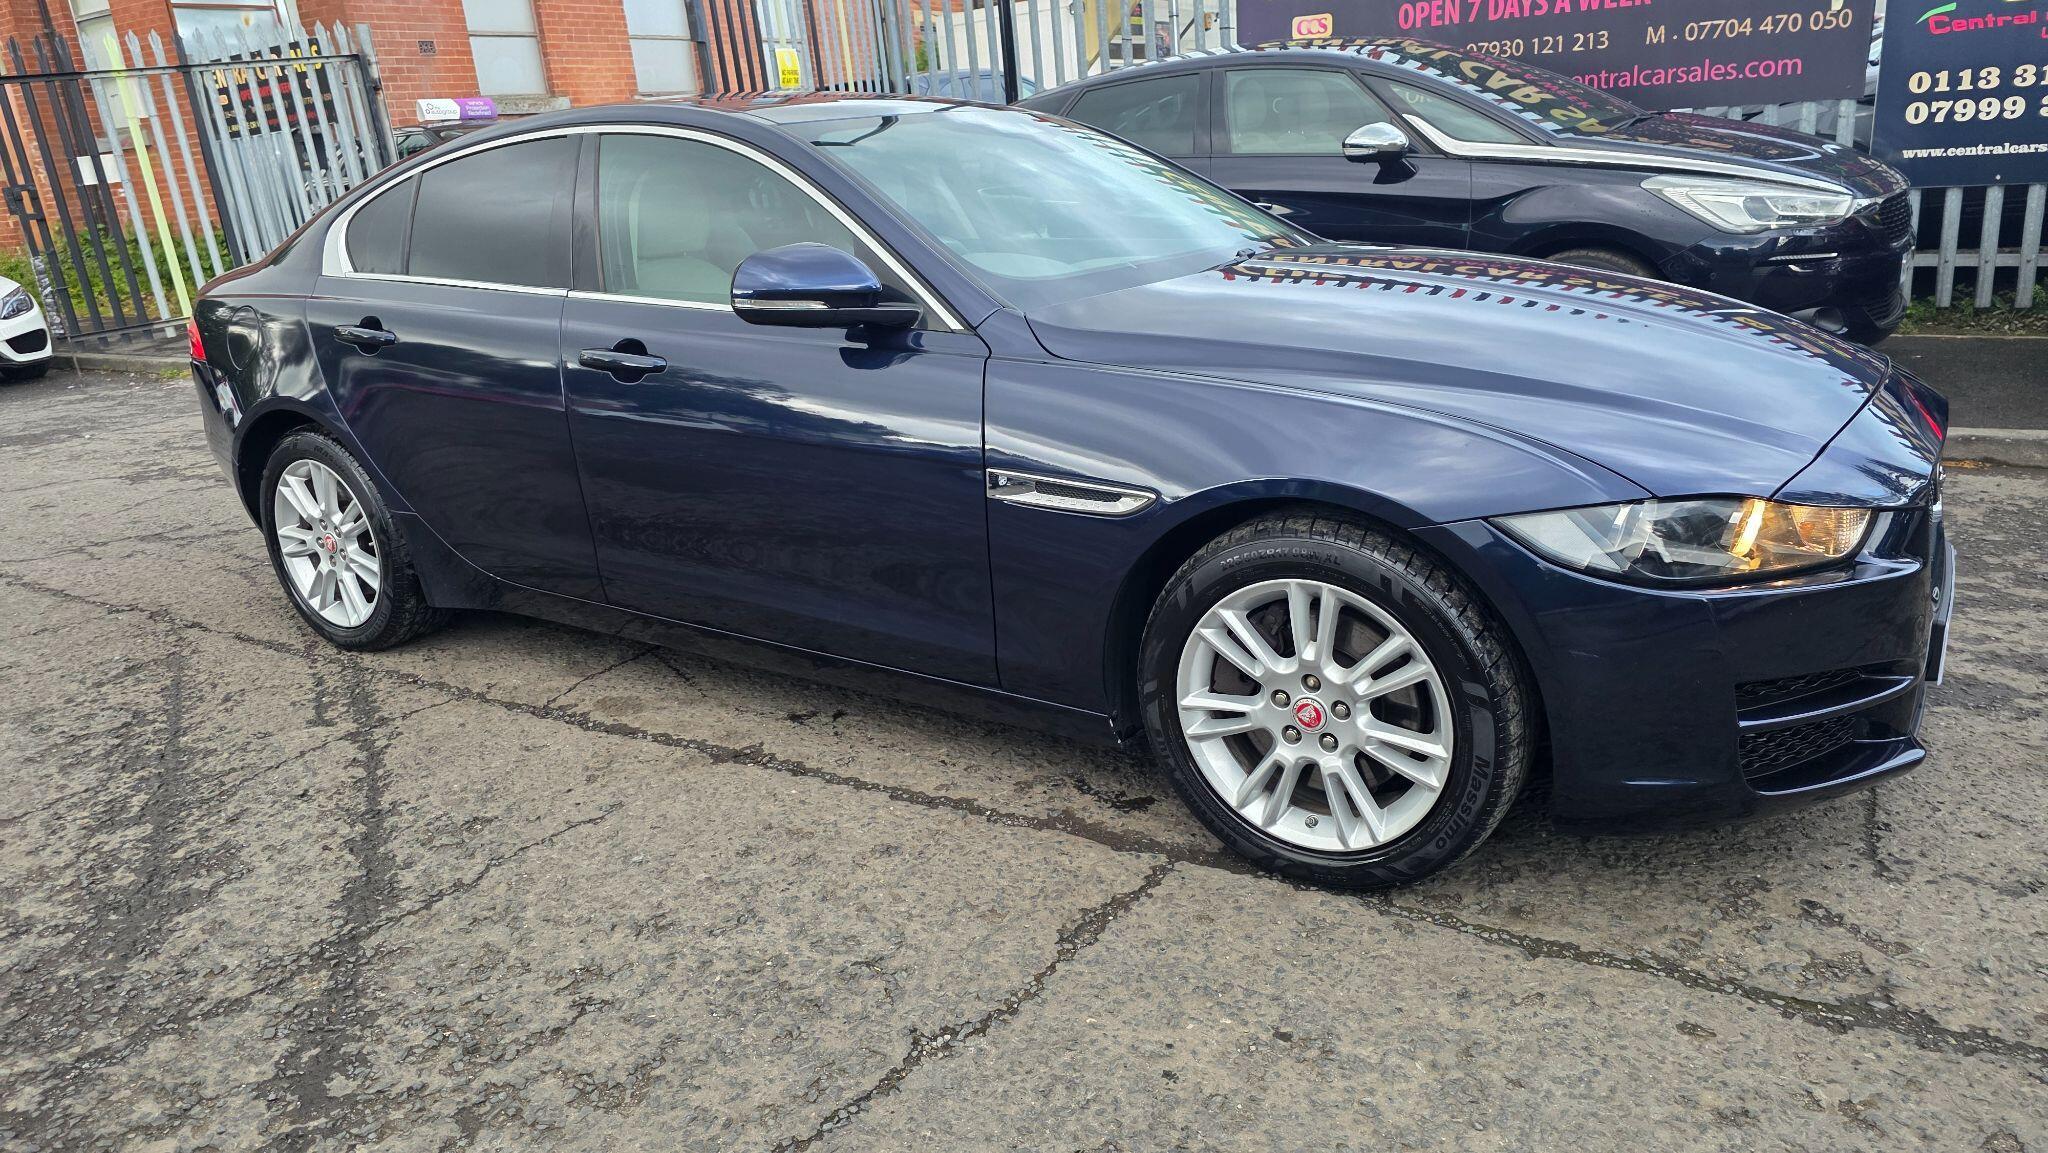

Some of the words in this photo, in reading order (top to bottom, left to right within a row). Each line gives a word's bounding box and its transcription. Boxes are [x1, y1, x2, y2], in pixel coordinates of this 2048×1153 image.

[1399, 0, 1460, 29] OPEN
[1468, 0, 1479, 22] 7
[1488, 0, 1548, 20] DAYS
[1929, 11, 2037, 35] Central
[1532, 36, 1563, 55] 121
[1572, 30, 1609, 51] 213
[1646, 25, 1665, 45] M
[1685, 18, 1752, 41] 07704
[1759, 13, 1802, 35] 470
[1809, 8, 1852, 31] 050
[1908, 67, 2001, 94] 0113
[1905, 96, 2026, 125] 07999
[1436, 754, 1491, 850] Massimo
